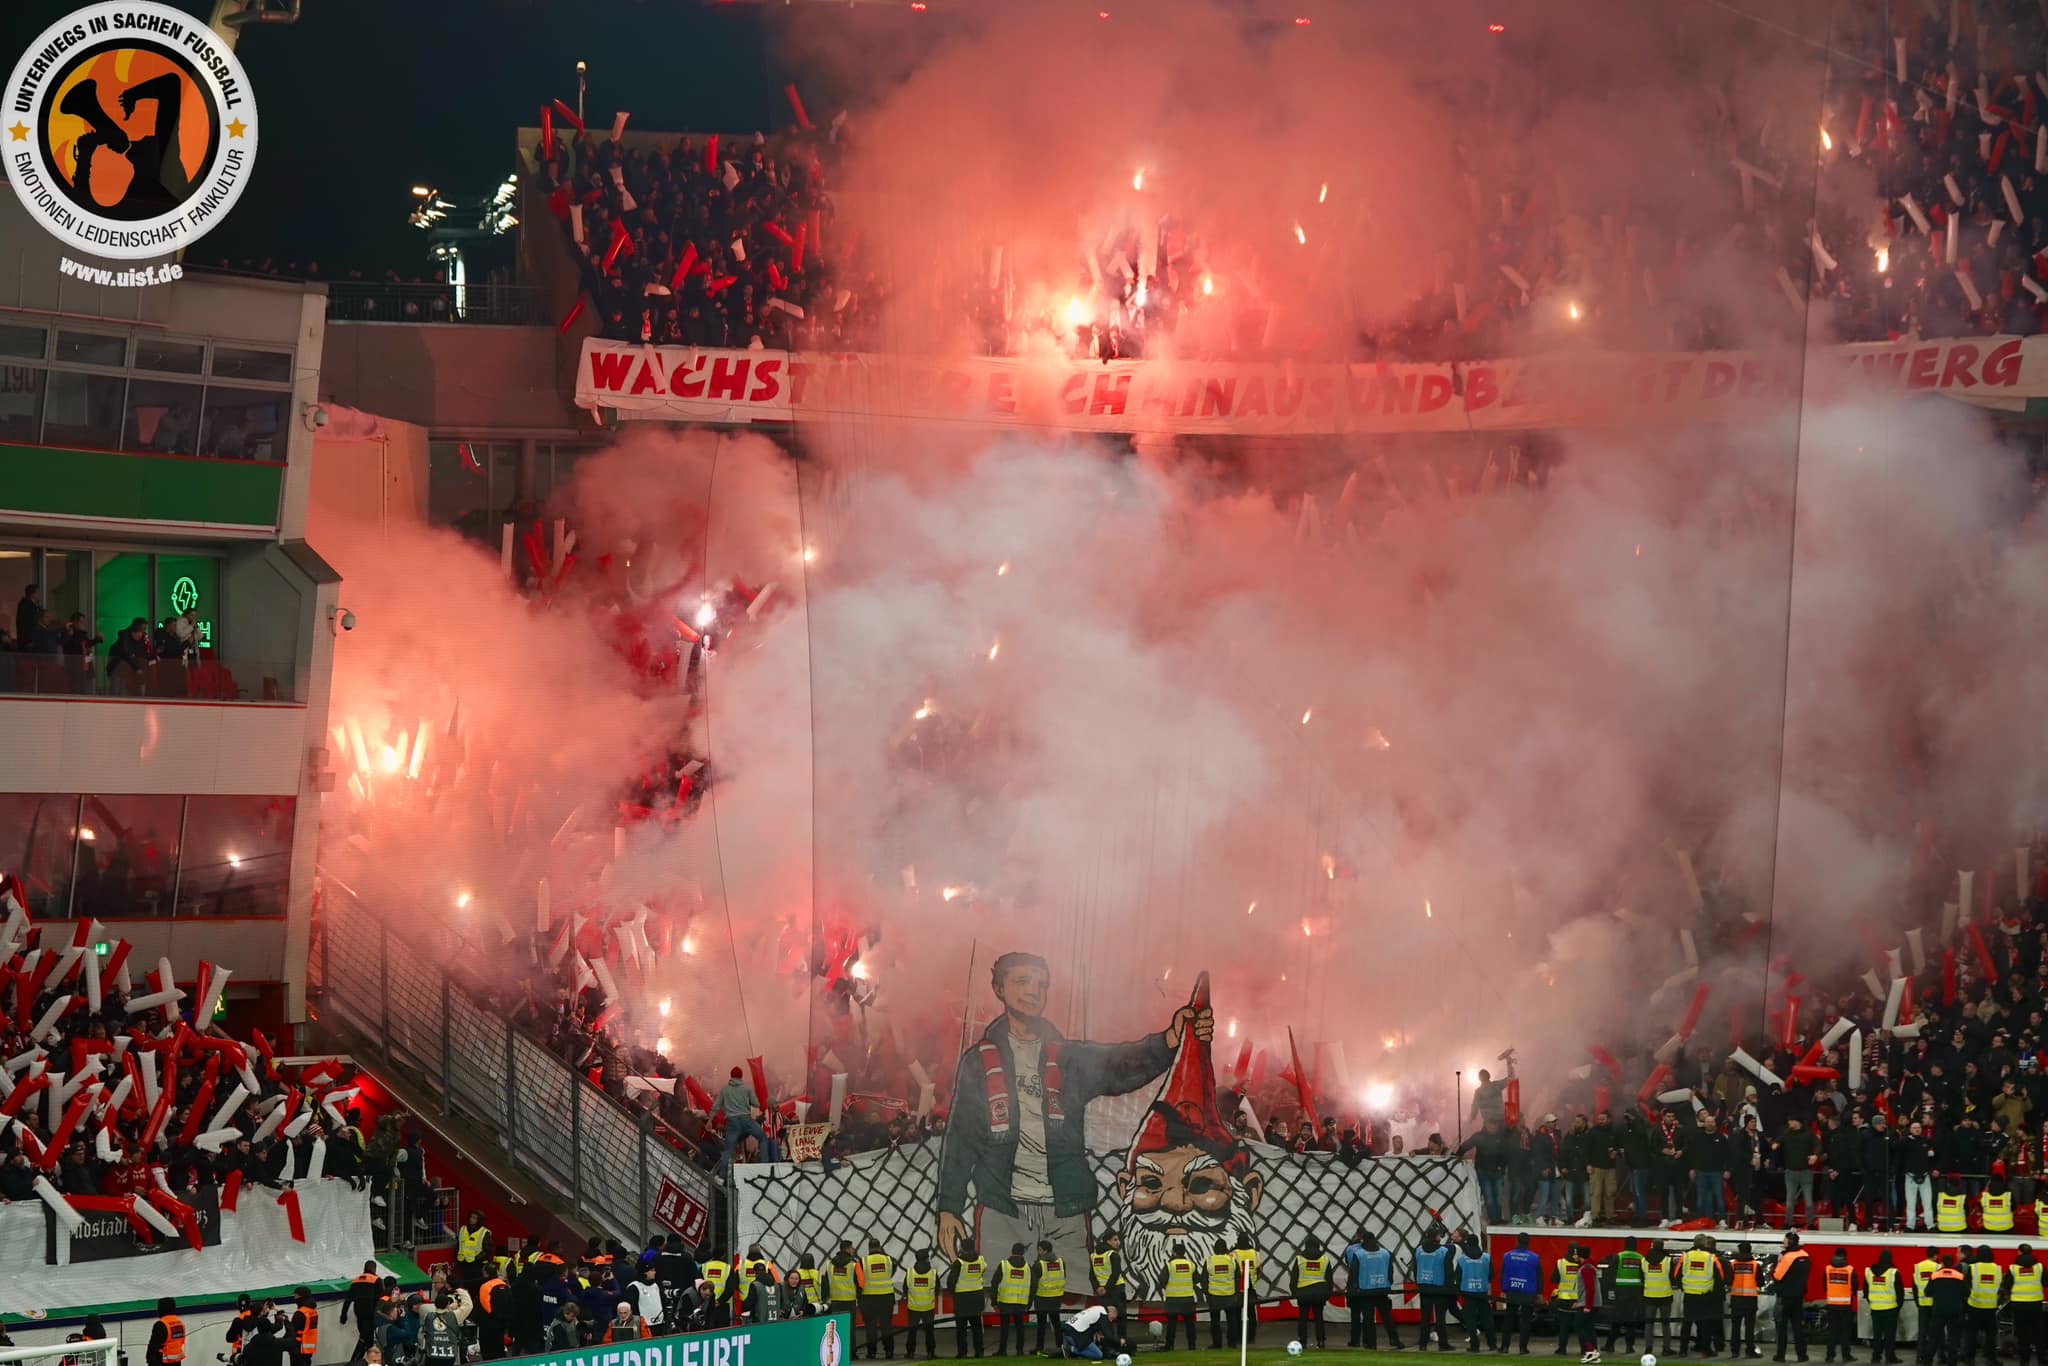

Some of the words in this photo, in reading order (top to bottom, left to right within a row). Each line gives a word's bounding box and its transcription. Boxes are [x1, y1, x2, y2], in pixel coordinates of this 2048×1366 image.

[988, 372, 1132, 418] ECH
[1347, 373, 1453, 417] UND
[1838, 340, 2023, 393] WERG
[431, 1345, 455, 1357] 111
